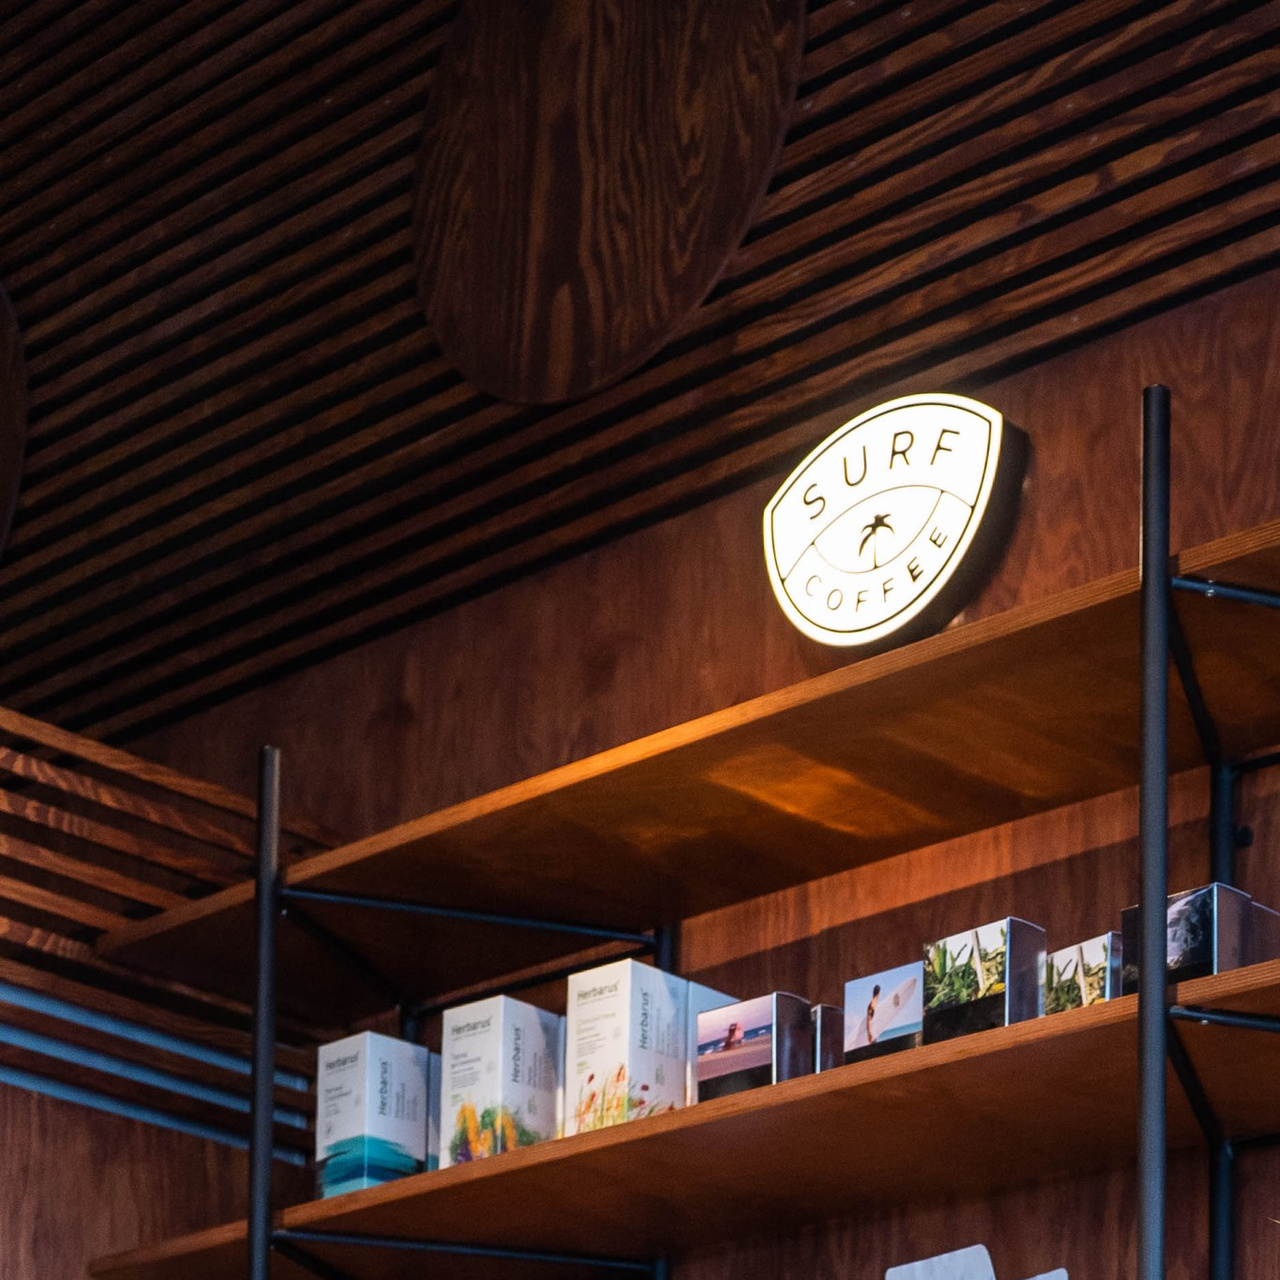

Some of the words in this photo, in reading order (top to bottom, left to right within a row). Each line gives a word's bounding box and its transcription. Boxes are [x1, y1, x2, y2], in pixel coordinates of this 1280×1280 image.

[803, 428, 960, 520] SURF
[805, 526, 948, 612] COFFEE
[639, 991, 649, 1050] Herbarus
